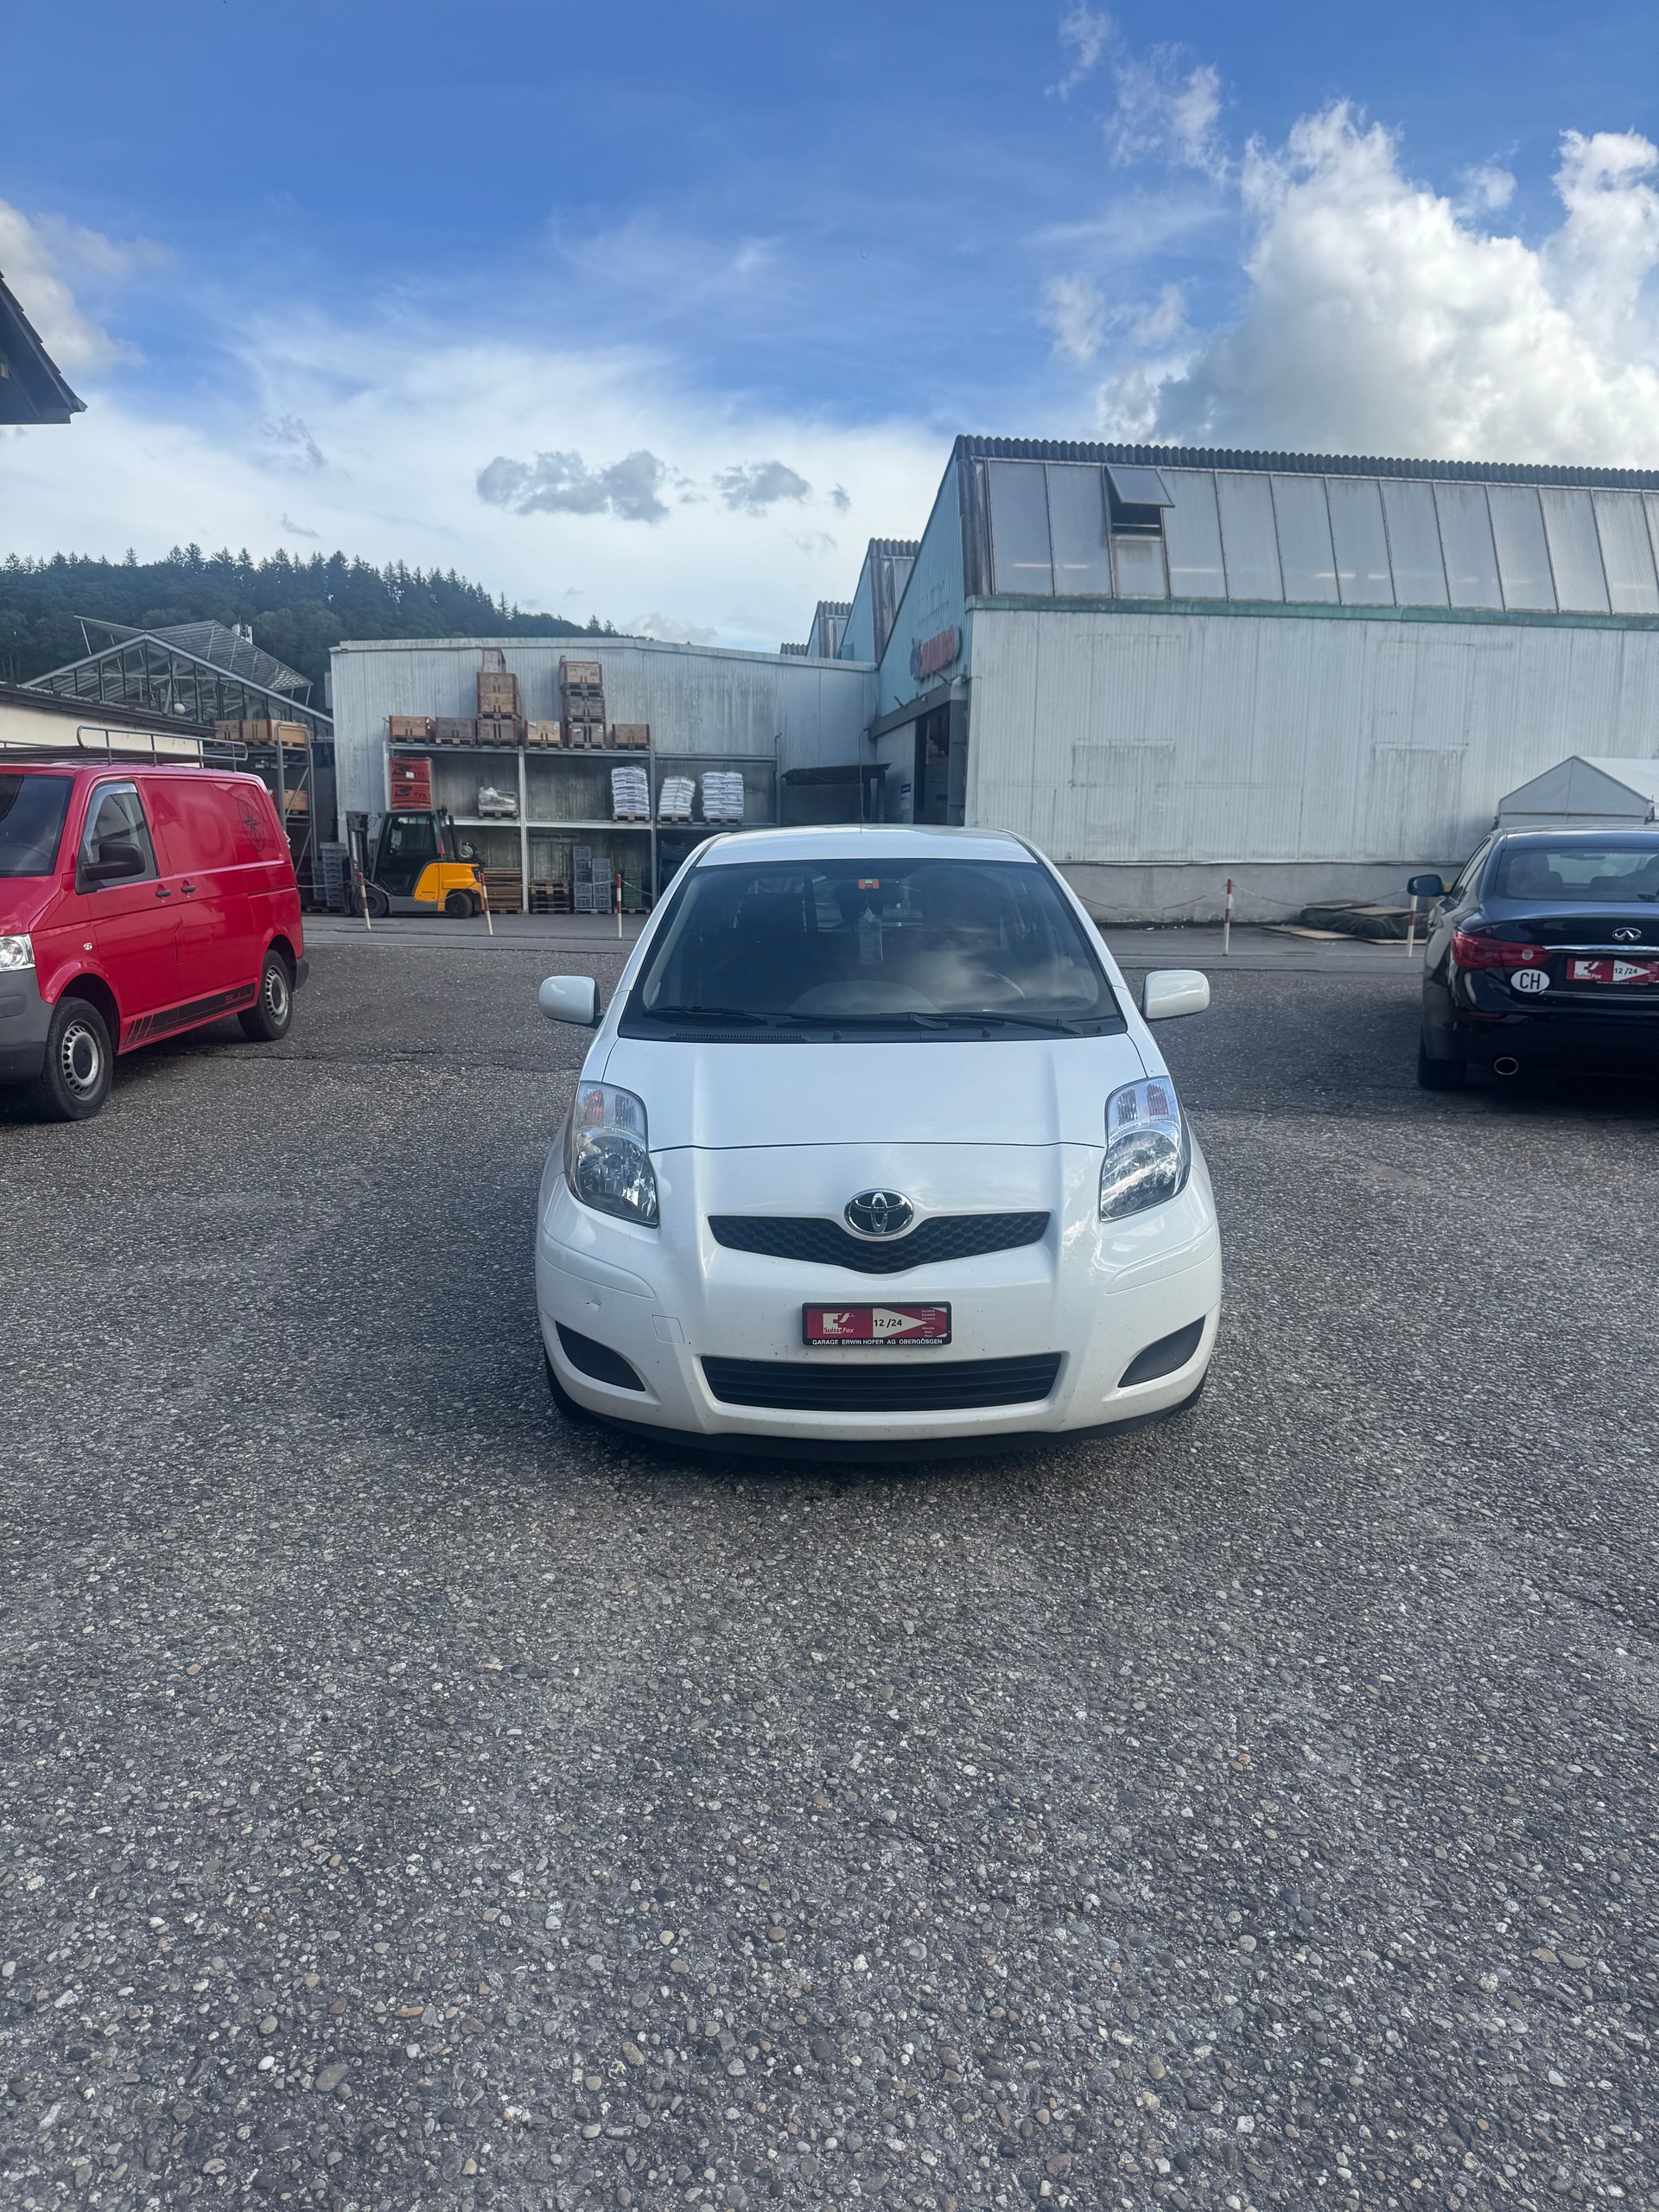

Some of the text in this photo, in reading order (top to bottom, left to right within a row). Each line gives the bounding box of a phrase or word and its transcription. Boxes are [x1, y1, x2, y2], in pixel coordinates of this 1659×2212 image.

[1520, 972, 1541, 989] CH
[874, 1318, 902, 1328] 12 /24
